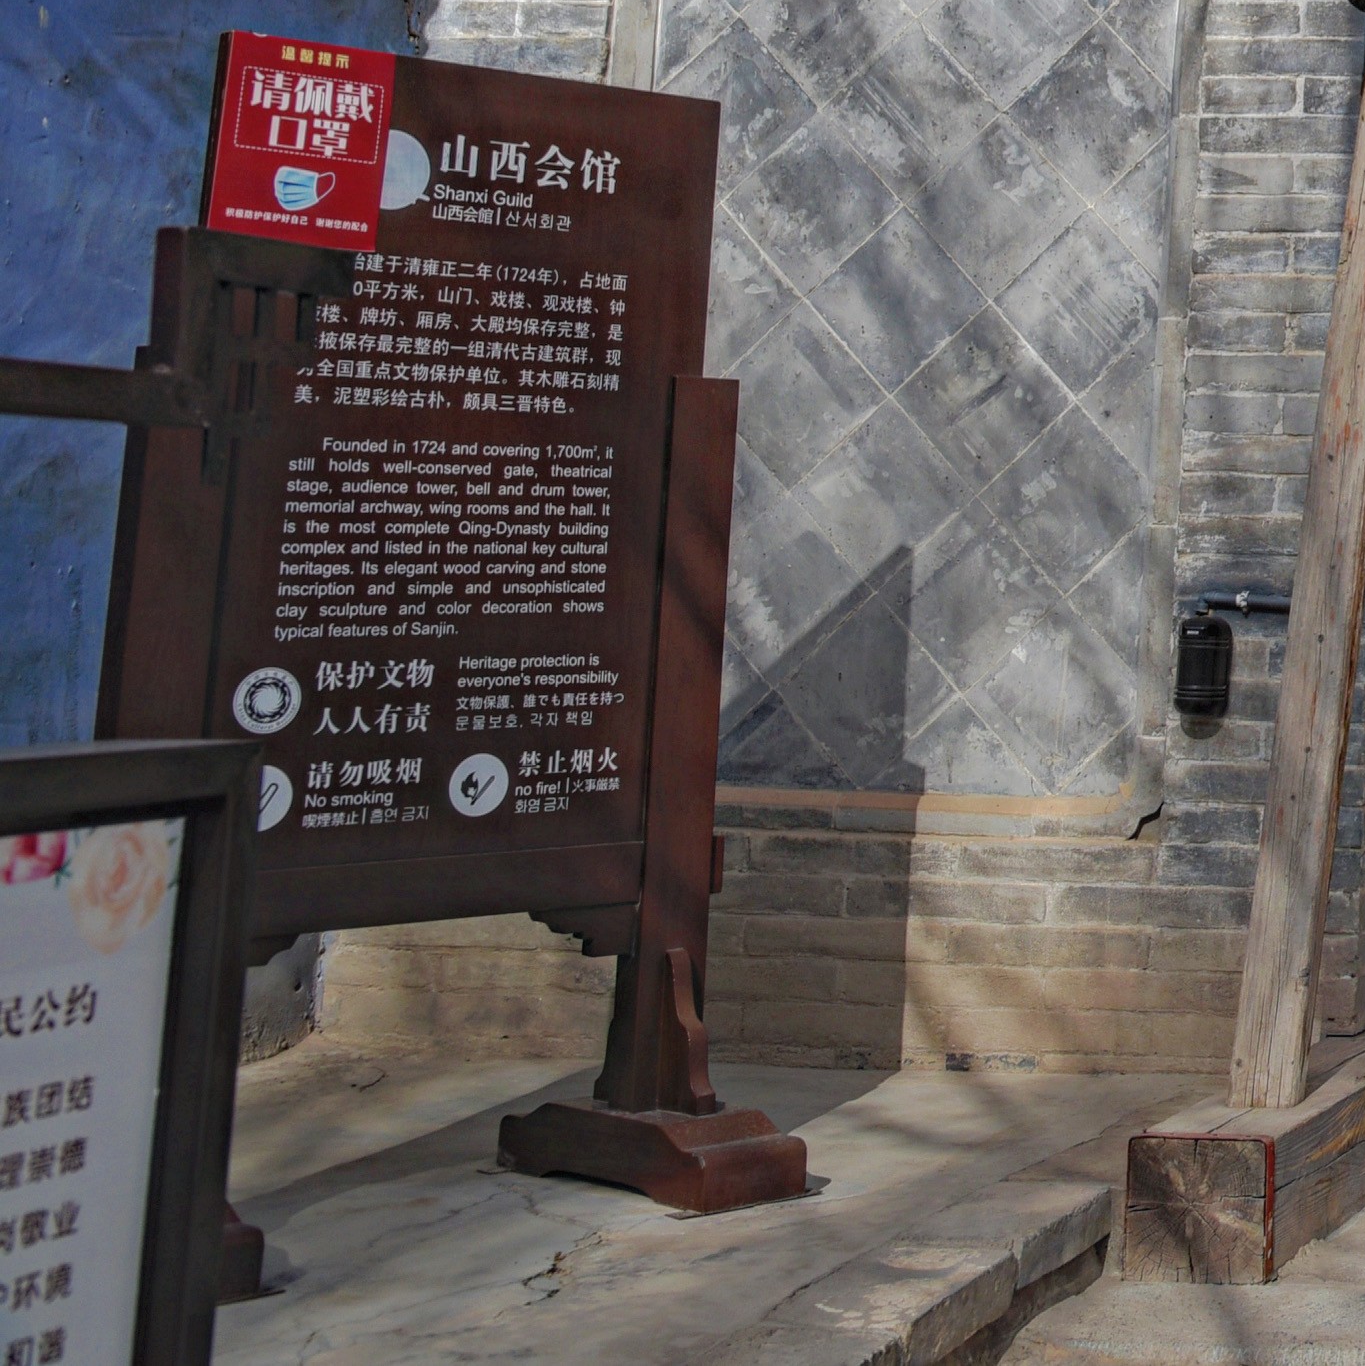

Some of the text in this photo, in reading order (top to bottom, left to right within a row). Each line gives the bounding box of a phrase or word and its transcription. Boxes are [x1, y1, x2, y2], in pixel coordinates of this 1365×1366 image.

[281, 45, 349, 69] 温馨提示
[250, 69, 375, 124] 请佩戴
[268, 115, 350, 157] 口罩
[440, 134, 622, 195] 山西会馆
[434, 184, 533, 208] Shanxi Guild
[225, 207, 368, 233] 积极防护保护好自己 谢谢您的配合
[505, 212, 571, 232] 산서회관
[314, 331, 622, 367] 掖保存最完整的一组清代古建筑群，现
[322, 437, 388, 453] Founded
[393, 439, 406, 453] in
[412, 440, 447, 454] 1724
[452, 442, 478, 456] and
[482, 443, 540, 460] covering
[605, 446, 614, 460] it
[288, 458, 613, 479] still holds well-conserved gate, theatrical
[287, 479, 611, 500] stage, audience tower, bell and drum tower,
[285, 500, 611, 518] memorial archway, wing rooms and the hall. It
[283, 520, 609, 539] is the most complete Qing-Dynasty building
[281, 541, 608, 558] complex and listed in the national key cultural
[279, 561, 607, 579] heritages. Its elegant wood carving and stone
[278, 581, 606, 599] inscription and simple and unsophisticated
[276, 600, 605, 621] clay sculpture and color decoration shows
[274, 621, 459, 642] typical features of Sanjin.
[459, 654, 599, 672] Heritage protection is
[314, 658, 435, 692] 保护文物
[457, 671, 619, 689] everyone's responsibility
[313, 704, 431, 736] 人人有责
[530, 713, 558, 726] 각자
[566, 711, 593, 726] 책임
[518, 747, 619, 777] 禁止烟火
[307, 757, 423, 789] 请勿吸烟
[304, 790, 393, 808] No smoking
[515, 781, 561, 796] no fire!
[401, 806, 429, 822] 금지
[544, 797, 569, 812] 금지
[302, 811, 359, 828] 喫煙禁止
